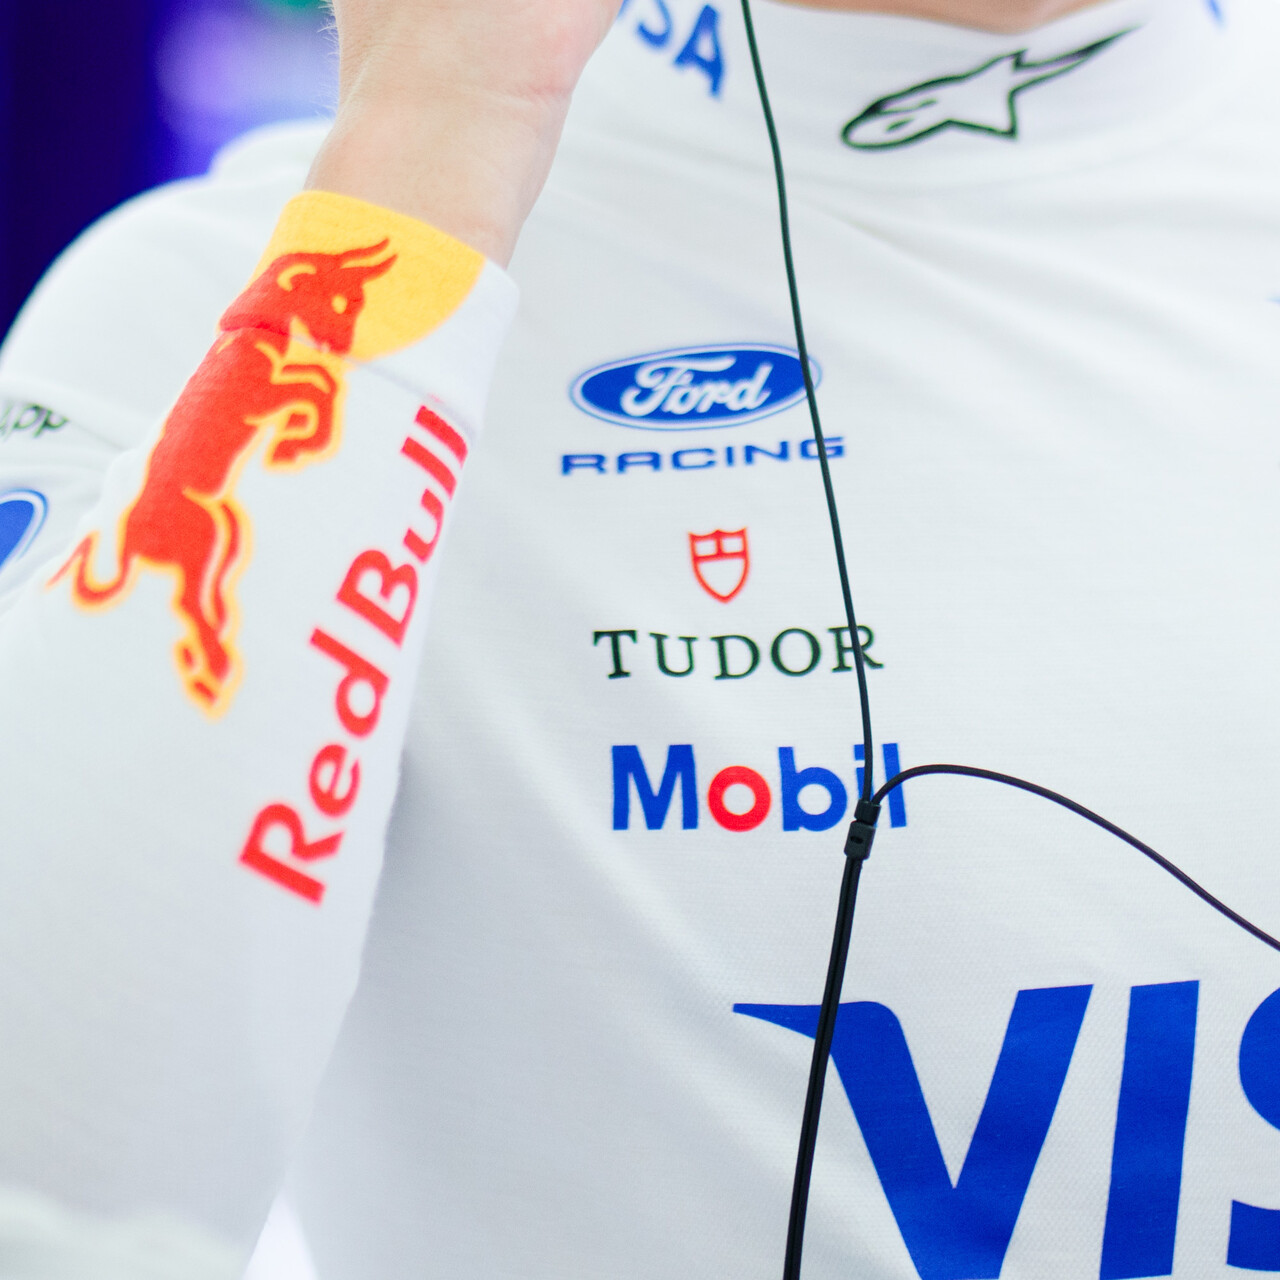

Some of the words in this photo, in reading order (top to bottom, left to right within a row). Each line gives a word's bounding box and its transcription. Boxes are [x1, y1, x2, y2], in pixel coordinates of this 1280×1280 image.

[621, 355, 773, 417] Ford
[561, 436, 846, 475] RACING
[238, 626, 391, 907] Red
[335, 405, 469, 650] Bull
[593, 624, 884, 680] TUDOR
[611, 742, 908, 832] Mobil
